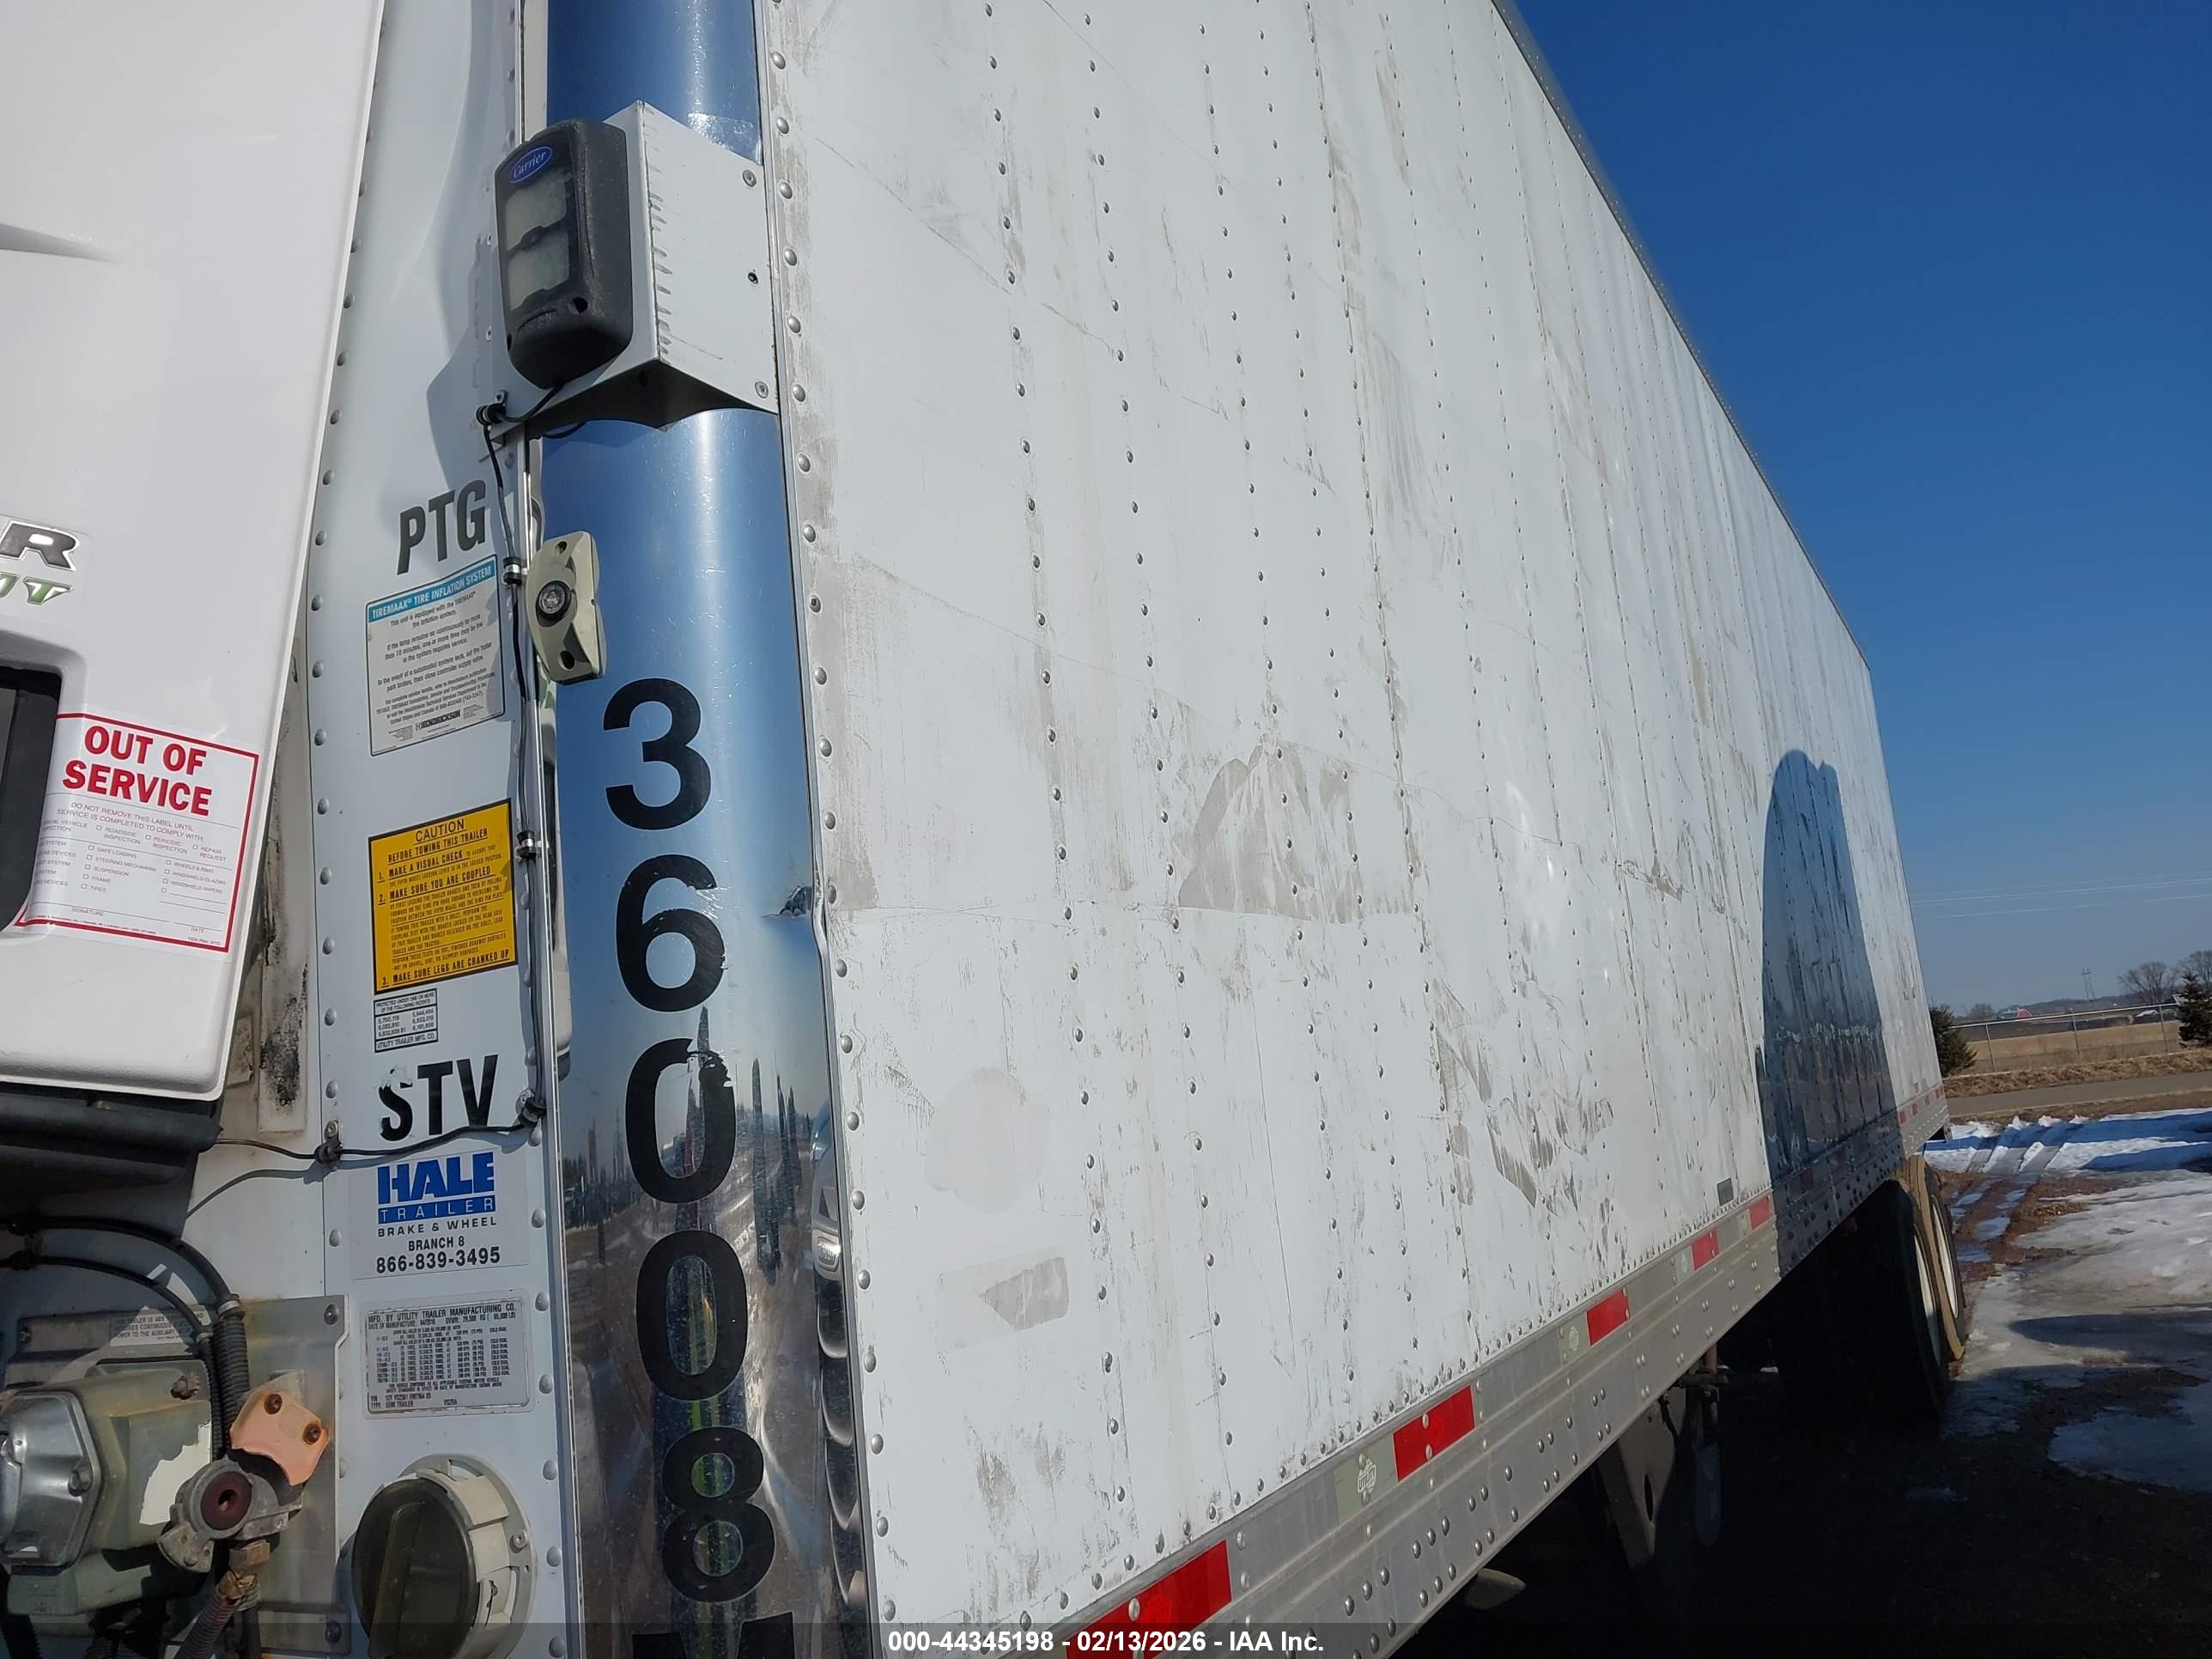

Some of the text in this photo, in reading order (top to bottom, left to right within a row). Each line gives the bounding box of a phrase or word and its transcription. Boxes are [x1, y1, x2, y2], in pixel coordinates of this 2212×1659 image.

[514, 152, 546, 178] Carrier
[397, 479, 486, 575] PTG
[415, 591, 429, 605] TIRE
[431, 577, 465, 600] INFLATION
[465, 566, 491, 586] SYSTEM
[422, 709, 460, 729] HENDRICKSON
[83, 724, 207, 778] OUT OF
[62, 757, 212, 817] SERVICE
[57, 807, 88, 820] SERVICE
[100, 816, 144, 830] COMPLETED
[156, 827, 185, 837] COMPLY
[185, 833, 203, 842] WITH
[101, 807, 132, 819] REMOVE
[134, 814, 150, 823] THIS
[151, 818, 173, 828] LABEL
[174, 823, 193, 832] UNTIL
[416, 818, 465, 842] CAUTION
[105, 834, 141, 845] INSPECTION
[106, 827, 137, 837] ROADSIDE
[154, 836, 181, 847] PERIODIC
[112, 850, 137, 859] LOADING
[153, 843, 187, 854] INSPECTION
[200, 853, 227, 862] REQUEST
[201, 846, 222, 854] REPAIR
[388, 828, 488, 863] BEFORE TOWING THIS TRAILER
[174, 861, 195, 870] WHEELS
[379, 850, 463, 880] 1. MAKE A VISUAL CHECK
[379, 866, 490, 902] 2. MAKE SURE YOU ARE COUPLED
[382, 948, 508, 986] 3. MAKE SURE LEGS ARE CRANKED UP
[395, 1036, 413, 1045] TRAILER
[379, 1054, 498, 1141] STV
[378, 1152, 495, 1205] HALE
[603, 678, 796, 1659] 36008
[380, 1198, 493, 1220] TRAILER
[378, 1217, 496, 1237] BRAKE & WHEEL
[409, 1236, 465, 1251] BRANCH 8
[377, 1247, 501, 1273] 866-839-3495
[368, 1315, 382, 1323] MFD.
[398, 1311, 418, 1321] UTILITY
[422, 1309, 446, 1319] TRAILER
[450, 1304, 501, 1316] MANUFACTURING
[506, 1303, 516, 1311] CO.
